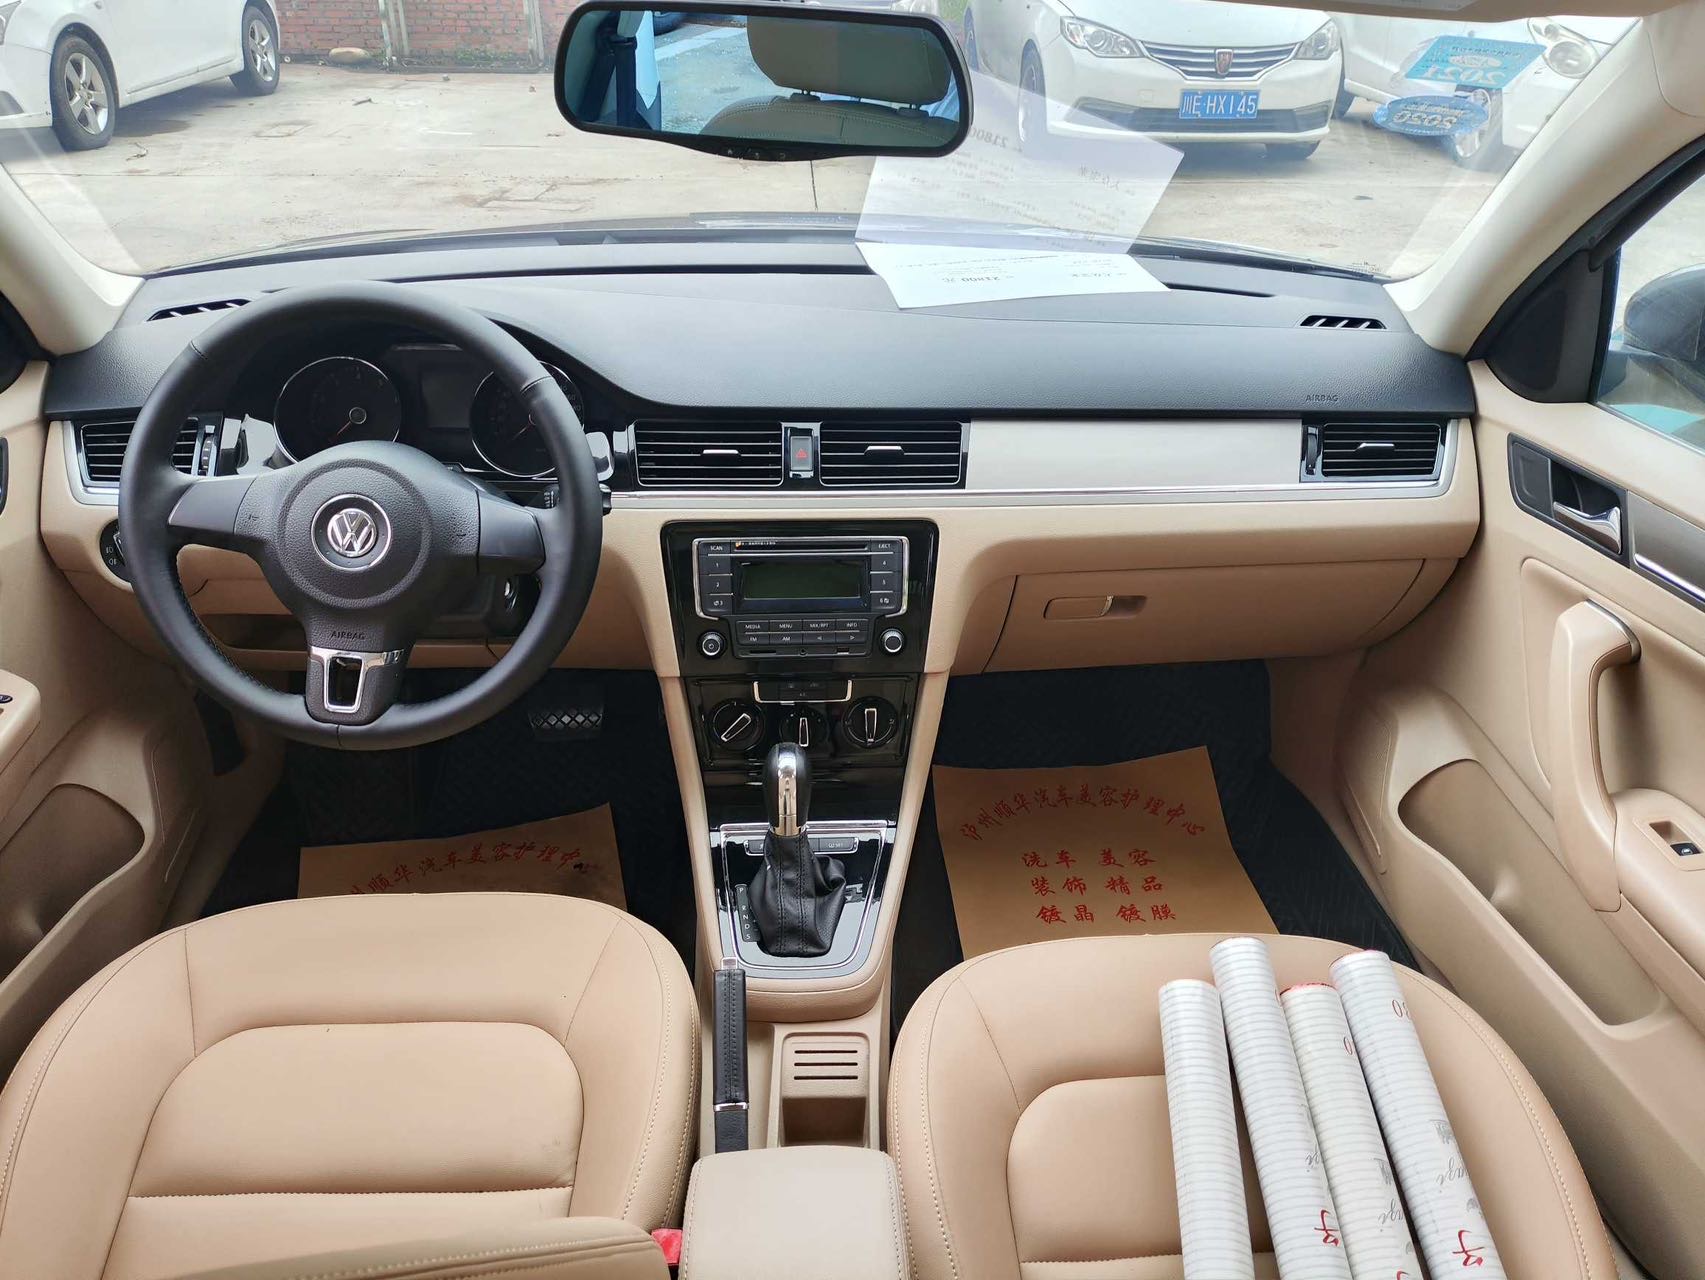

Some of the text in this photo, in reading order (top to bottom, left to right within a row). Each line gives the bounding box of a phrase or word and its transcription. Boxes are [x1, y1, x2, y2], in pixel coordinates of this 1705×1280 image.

[1305, 394, 1339, 402] AIRBAG
[330, 630, 366, 641] AIRBAG
[1022, 847, 1157, 869] 洗车 美容
[1030, 875, 1163, 897] 装饰 精品
[1036, 903, 1177, 925] 镀晶 镀膜
[1452, 1229, 1486, 1267] 子
